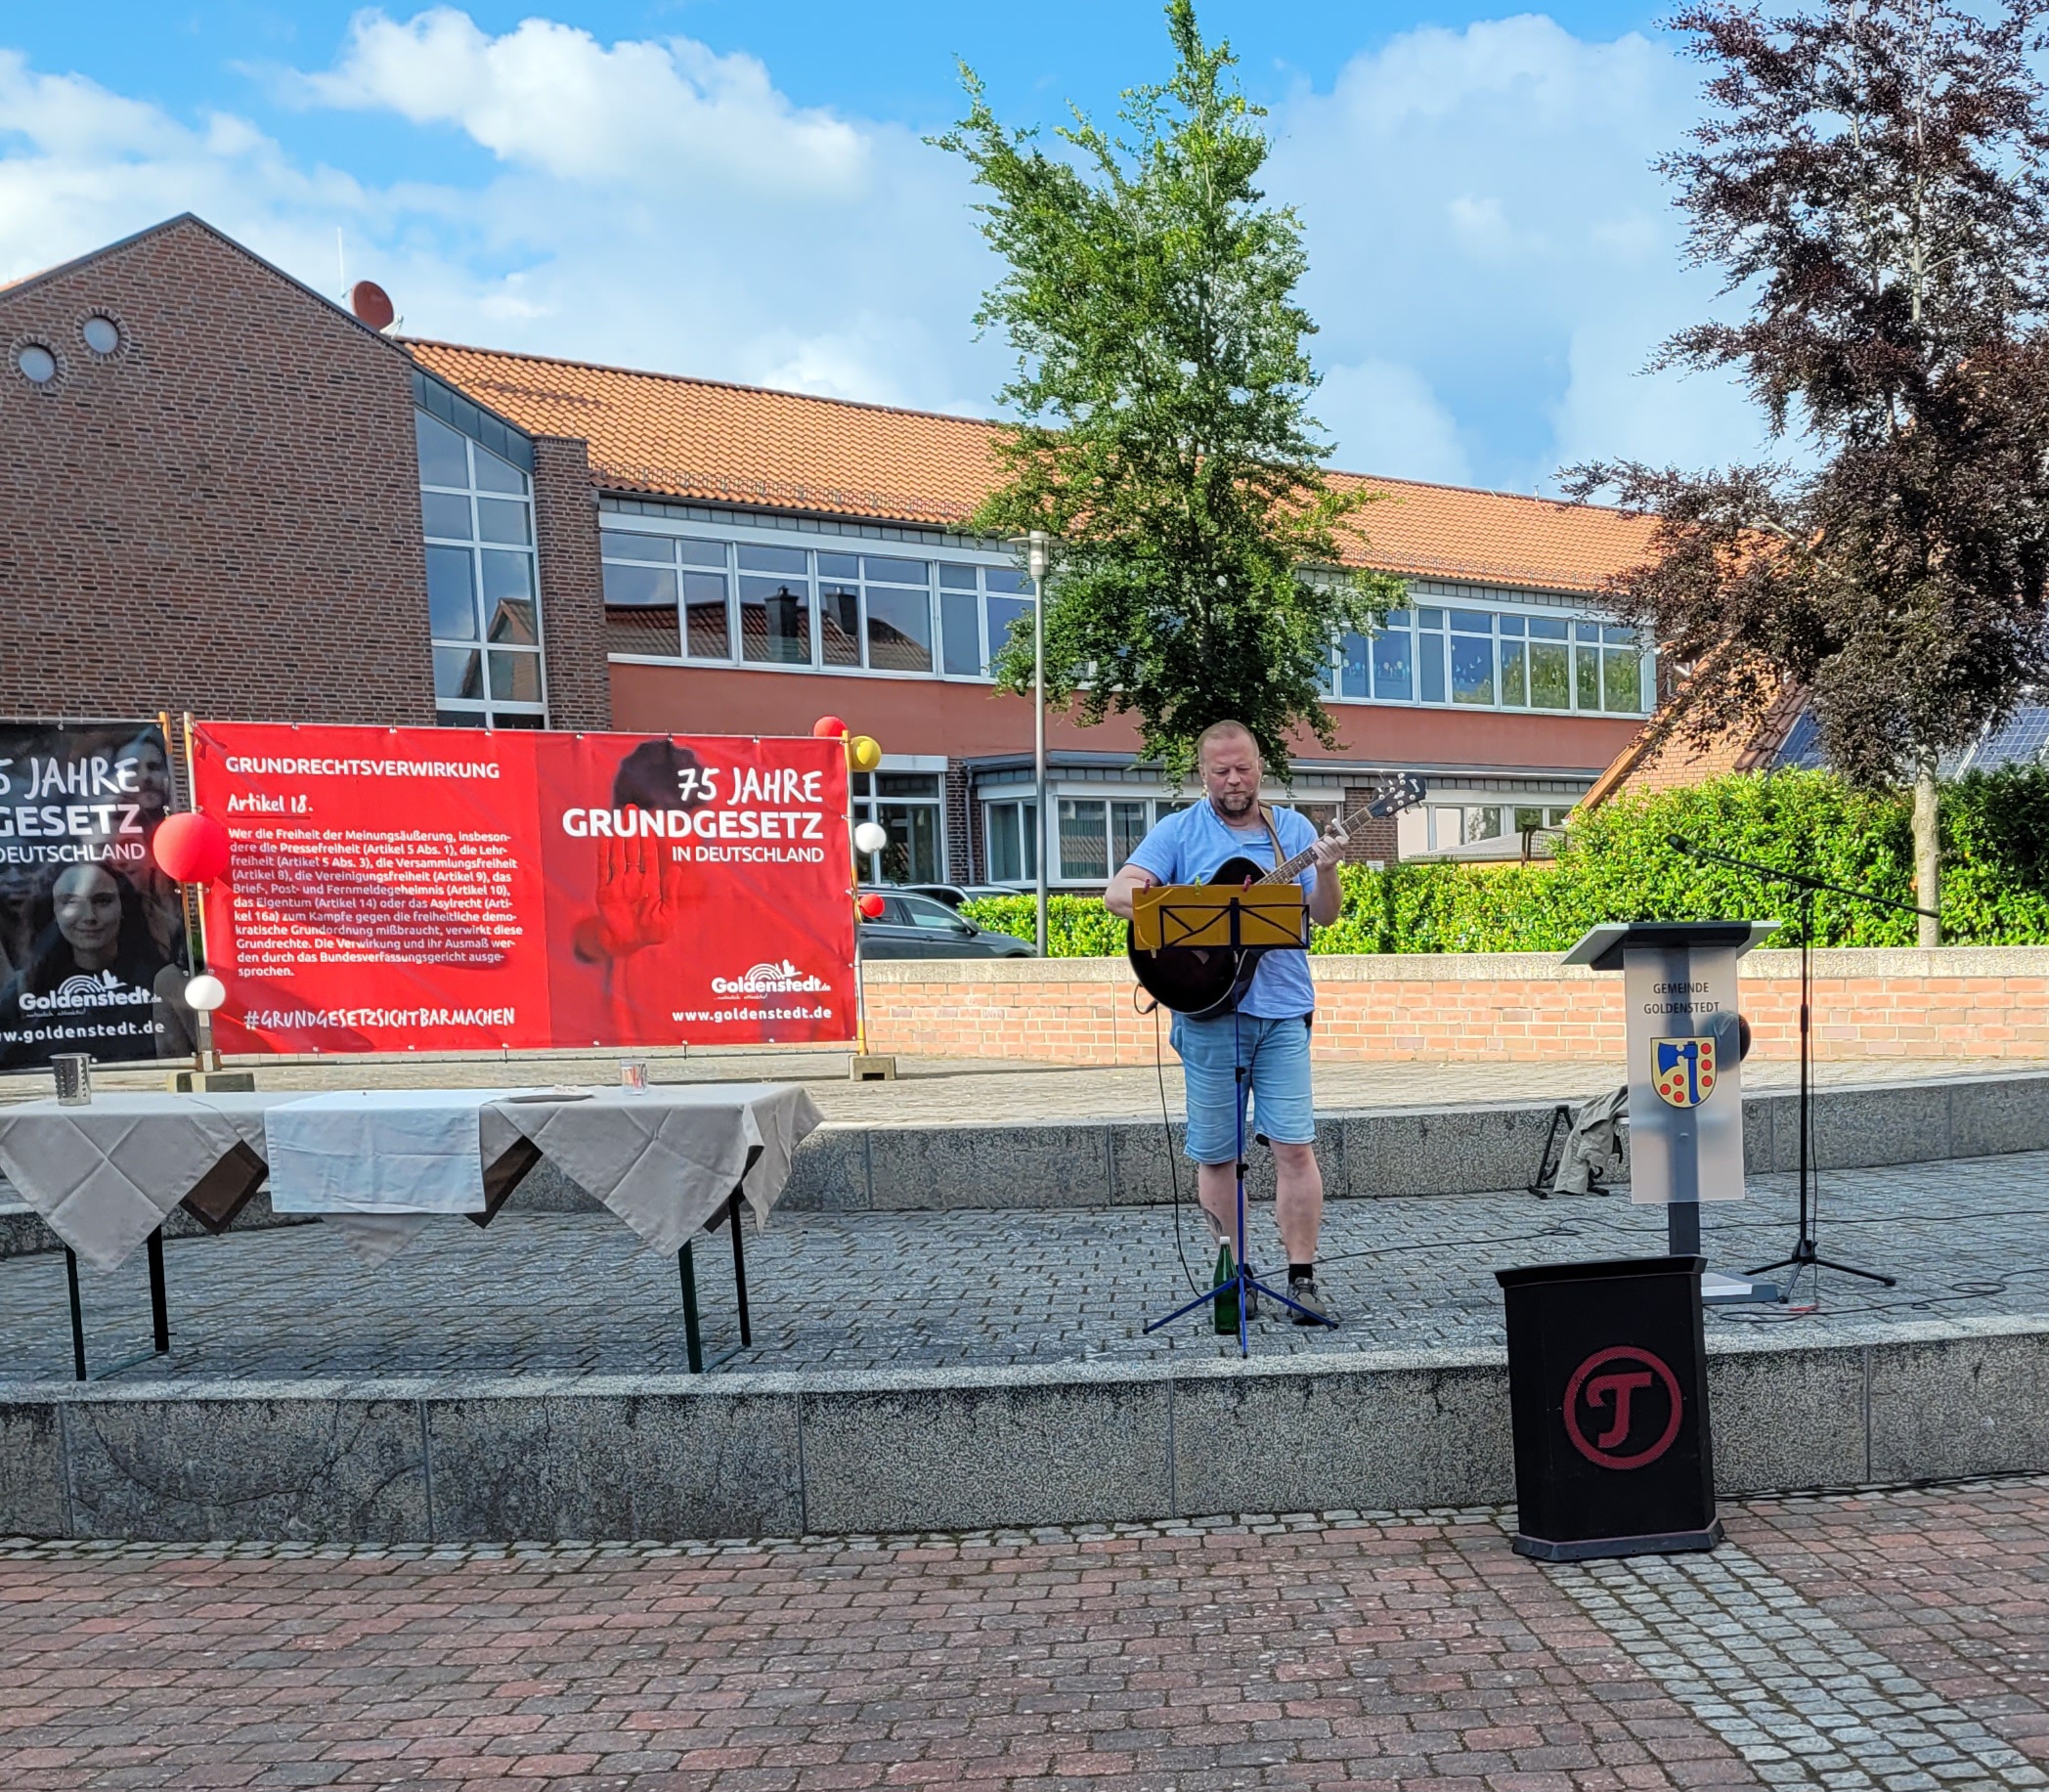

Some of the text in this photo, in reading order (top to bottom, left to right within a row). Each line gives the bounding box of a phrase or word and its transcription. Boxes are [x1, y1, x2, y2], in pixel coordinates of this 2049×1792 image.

[226, 757, 500, 779] GRUNDRECHTSVERWIRKUNG
[23, 756, 140, 800] JAHRE
[677, 767, 823, 806] 75 JAHRE
[228, 793, 314, 813] Artikel 18.
[562, 808, 824, 840] GRUNDGESETZ
[228, 828, 511, 843] Wer die Freiheit der Meinungsäußerung, insbeson-
[229, 843, 508, 856] dere die Pressefreiheit (Artikel 5 Abs. 1), die Lehr-
[673, 846, 824, 862] IN DEUTSCHLAND
[231, 855, 518, 870] freiheit (Artikel 5 Abs. 3), die Versammlungsfreiheit
[233, 870, 275, 882] (Artikel
[295, 870, 313, 880] die
[315, 870, 430, 883] Vereinigungsfreiheit
[433, 871, 473, 882] (Artikel
[476, 872, 491, 883] 9),
[493, 872, 512, 882] das
[271, 884, 300, 894] Post-
[303, 884, 325, 895] und
[327, 884, 444, 896] Fernmeldegeheimnis
[447, 885, 487, 896] (Artikel
[490, 886, 510, 896] 10),
[234, 897, 512, 909] das Eigentum (Artikel 14) oder das Asylrecht (Arti-
[234, 910, 251, 921] kel
[255, 911, 280, 923] 16a)
[309, 911, 352, 923] Kampfe
[355, 912, 391, 923] gegen
[393, 911, 411, 921] die
[413, 911, 479, 922] freiheitliche
[482, 911, 517, 922] demo-
[235, 925, 523, 937] kratische Grundordnung mißbraucht, verwirkt diese
[237, 939, 312, 948] Grundrechte.
[315, 939, 334, 948] Die
[336, 939, 401, 950] Verwirkung
[404, 939, 424, 948] und
[445, 939, 489, 948] Ausmaß
[491, 940, 515, 948] wer-
[238, 951, 504, 964] den durch das Bundesverfassungsgericht ausge-
[239, 966, 294, 978] sprochen.
[1653, 982, 1709, 994] GEMEINDE
[673, 1006, 832, 1024] www.goldenstedt.de
[1644, 1001, 1721, 1015] GOLDENSTEDT
[244, 1007, 515, 1028] #GRUNDGESETZSICHTBARMACHEN
[0, 1020, 165, 1043] w.goldenstedt.de
